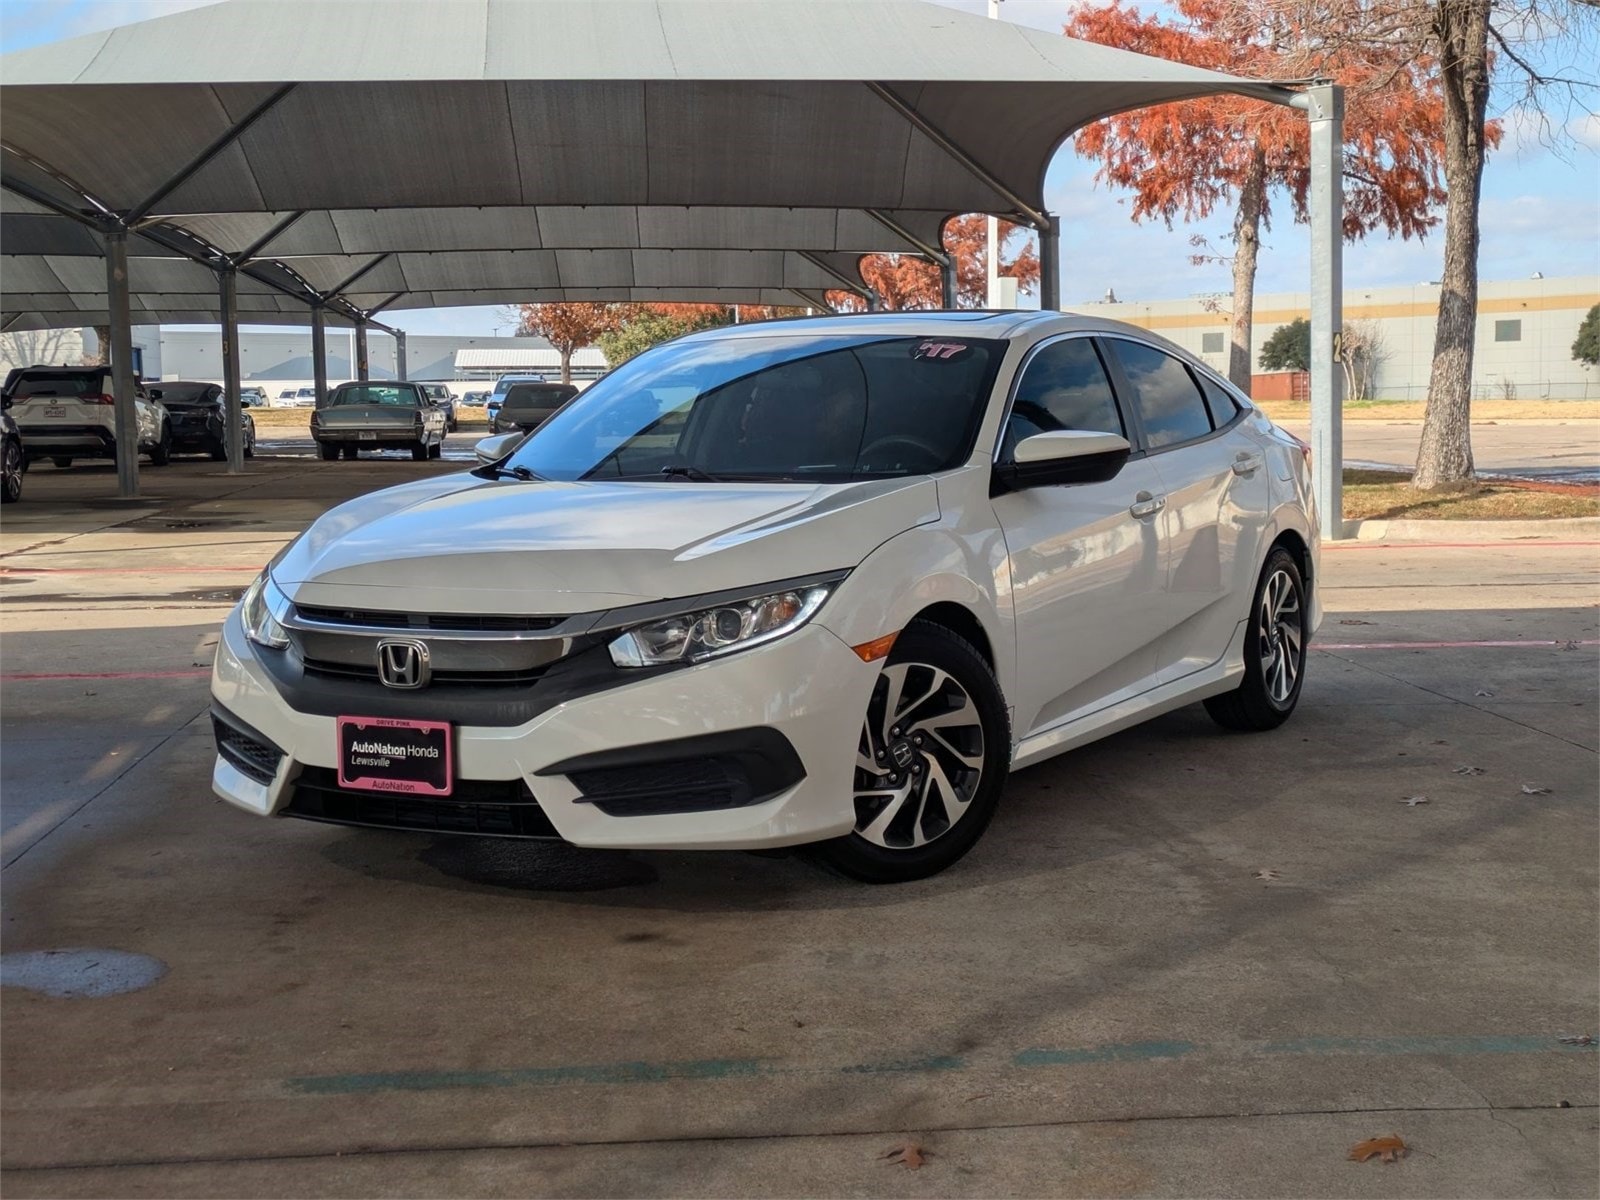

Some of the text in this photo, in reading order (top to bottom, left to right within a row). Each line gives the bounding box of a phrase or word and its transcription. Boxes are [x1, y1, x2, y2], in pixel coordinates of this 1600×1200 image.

[1333, 333, 1341, 362] 2
[351, 741, 439, 758] AutoNation Honda
[351, 755, 390, 767] Lewisville
[372, 780, 415, 792] AutoNation
